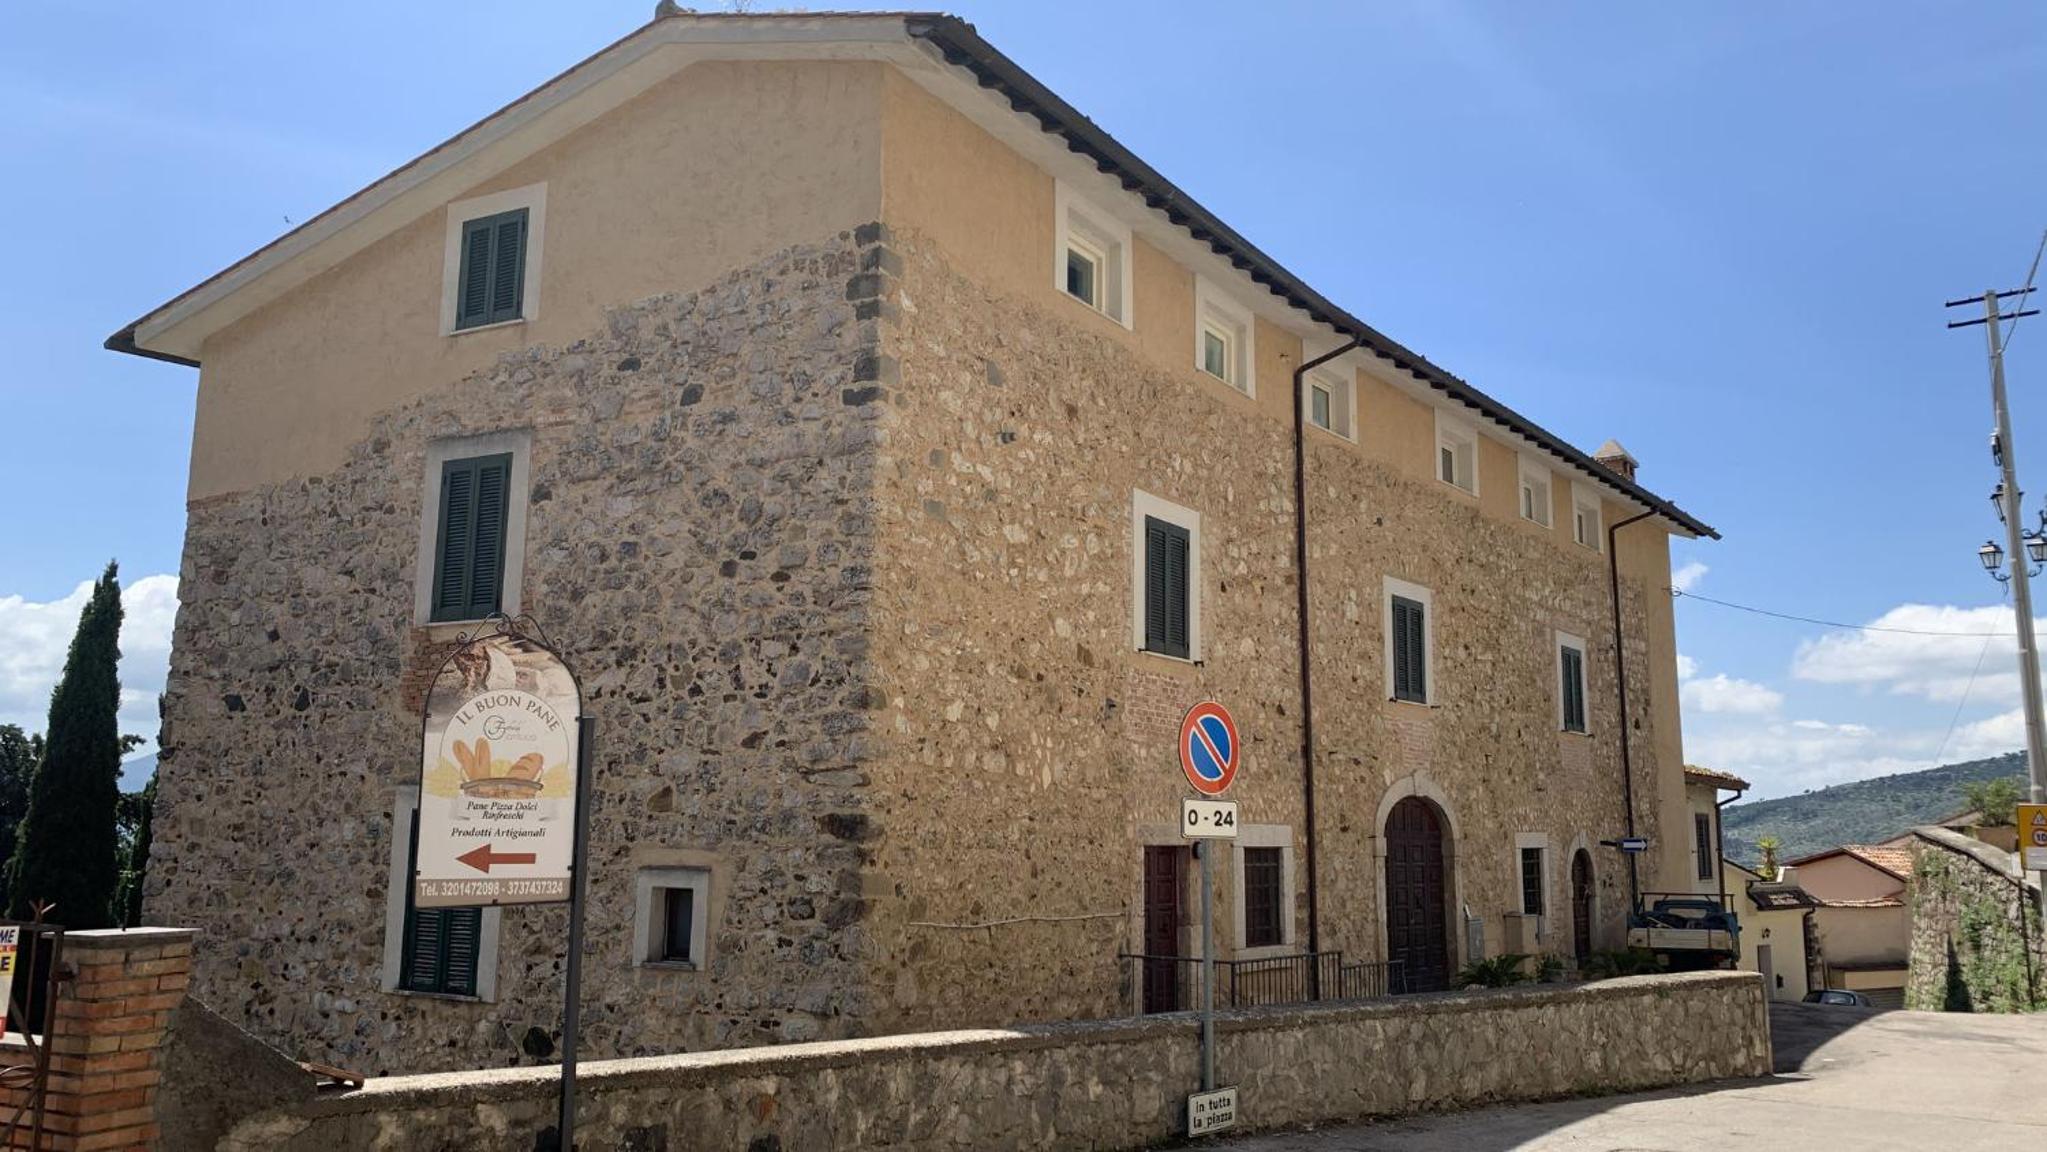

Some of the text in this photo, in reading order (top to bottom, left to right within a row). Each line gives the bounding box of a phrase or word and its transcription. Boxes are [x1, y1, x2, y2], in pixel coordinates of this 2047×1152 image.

[475, 695, 521, 713] BUON
[525, 699, 560, 732] PANE
[466, 801, 538, 811] Pane Pizza Dolci
[482, 810, 524, 821] Rinfreschi
[1188, 809, 1198, 826] 0
[1213, 810, 1234, 827] 24
[450, 827, 546, 840] Prodotti Artigianali
[420, 882, 438, 896] Tel.
[441, 881, 500, 896] 3201472098
[507, 880, 564, 896] 3737437324
[1208, 1096, 1231, 1110] tutta
[1193, 1111, 1232, 1129] la piazza
